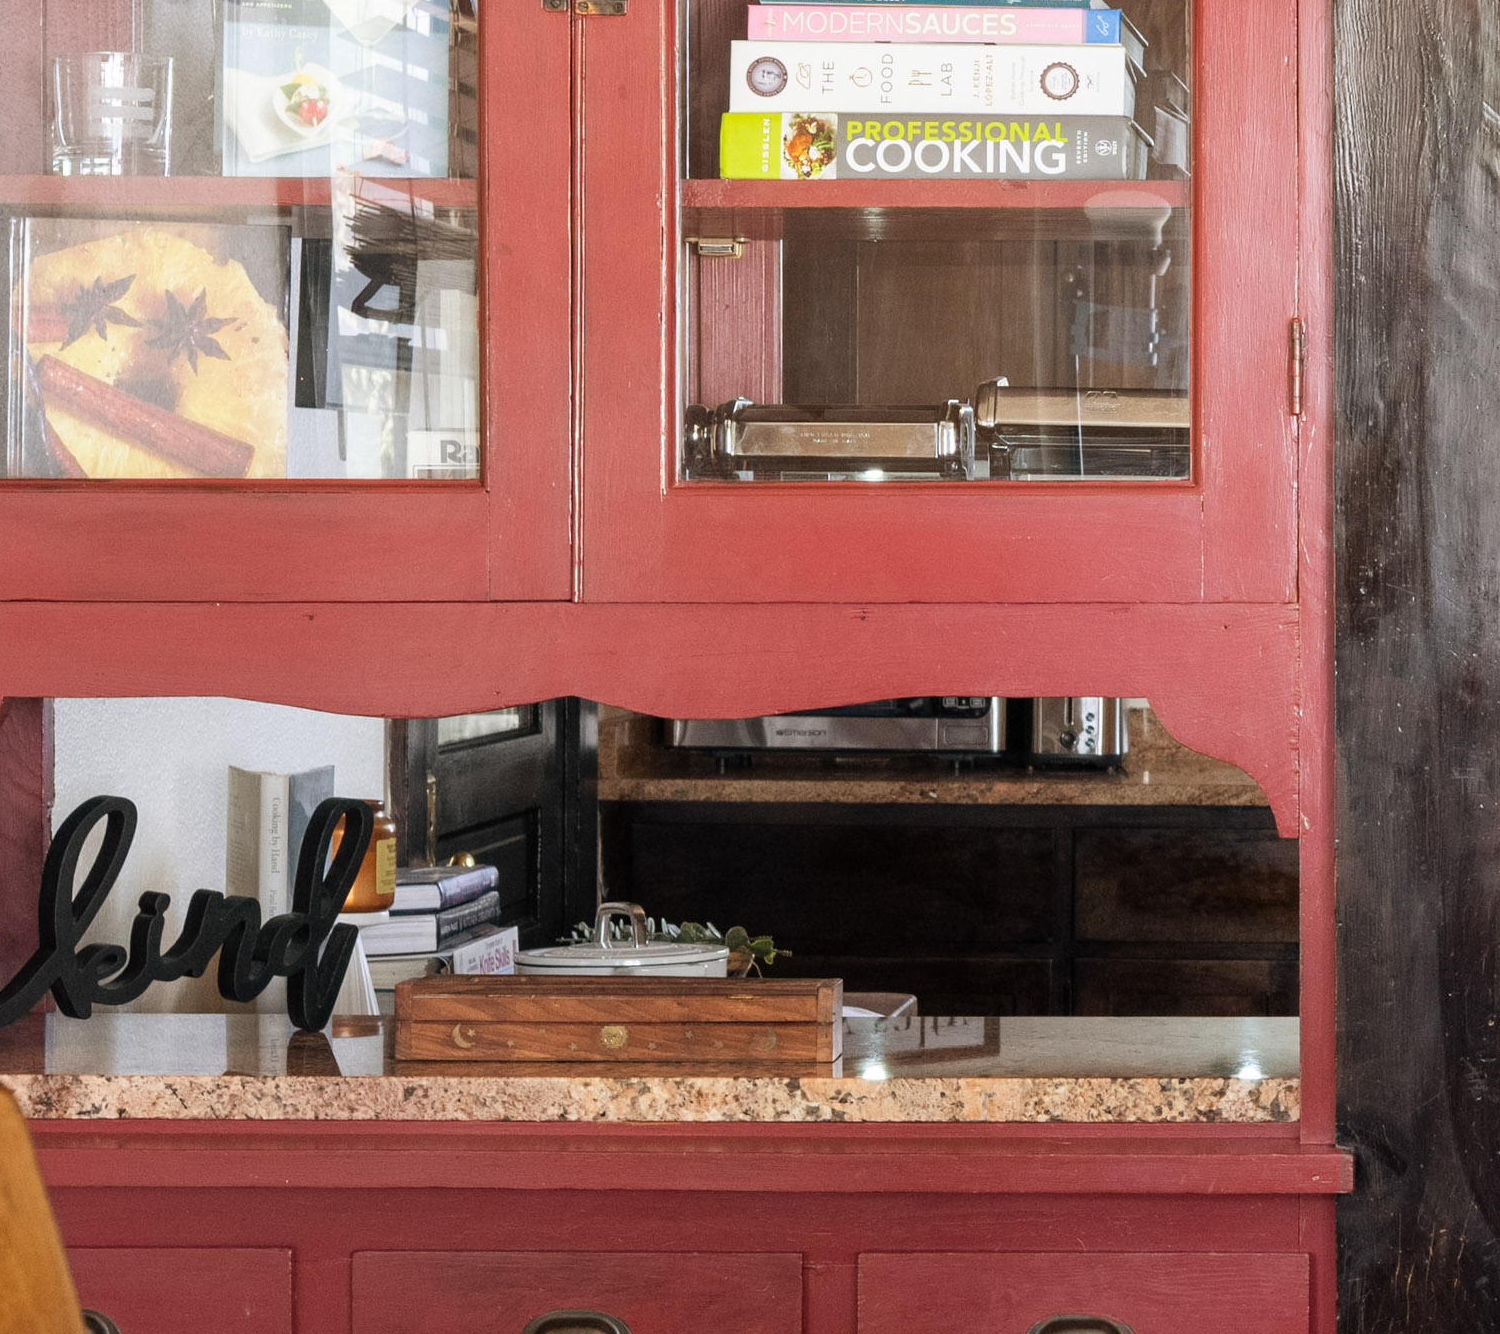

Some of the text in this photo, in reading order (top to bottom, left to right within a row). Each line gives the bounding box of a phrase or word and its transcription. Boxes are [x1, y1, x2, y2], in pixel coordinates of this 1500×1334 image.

[822, 61, 835, 94] THE
[881, 53, 893, 103] FOOD
[940, 63, 953, 97] LAB
[762, 118, 770, 172] GISSLEN
[846, 120, 1068, 142] PROFESSIONAL
[845, 137, 1067, 174] COOKING
[269, 797, 281, 834] Cooking
[269, 836, 281, 846] by
[271, 849, 281, 874] Hand
[37, 795, 375, 1033] kind
